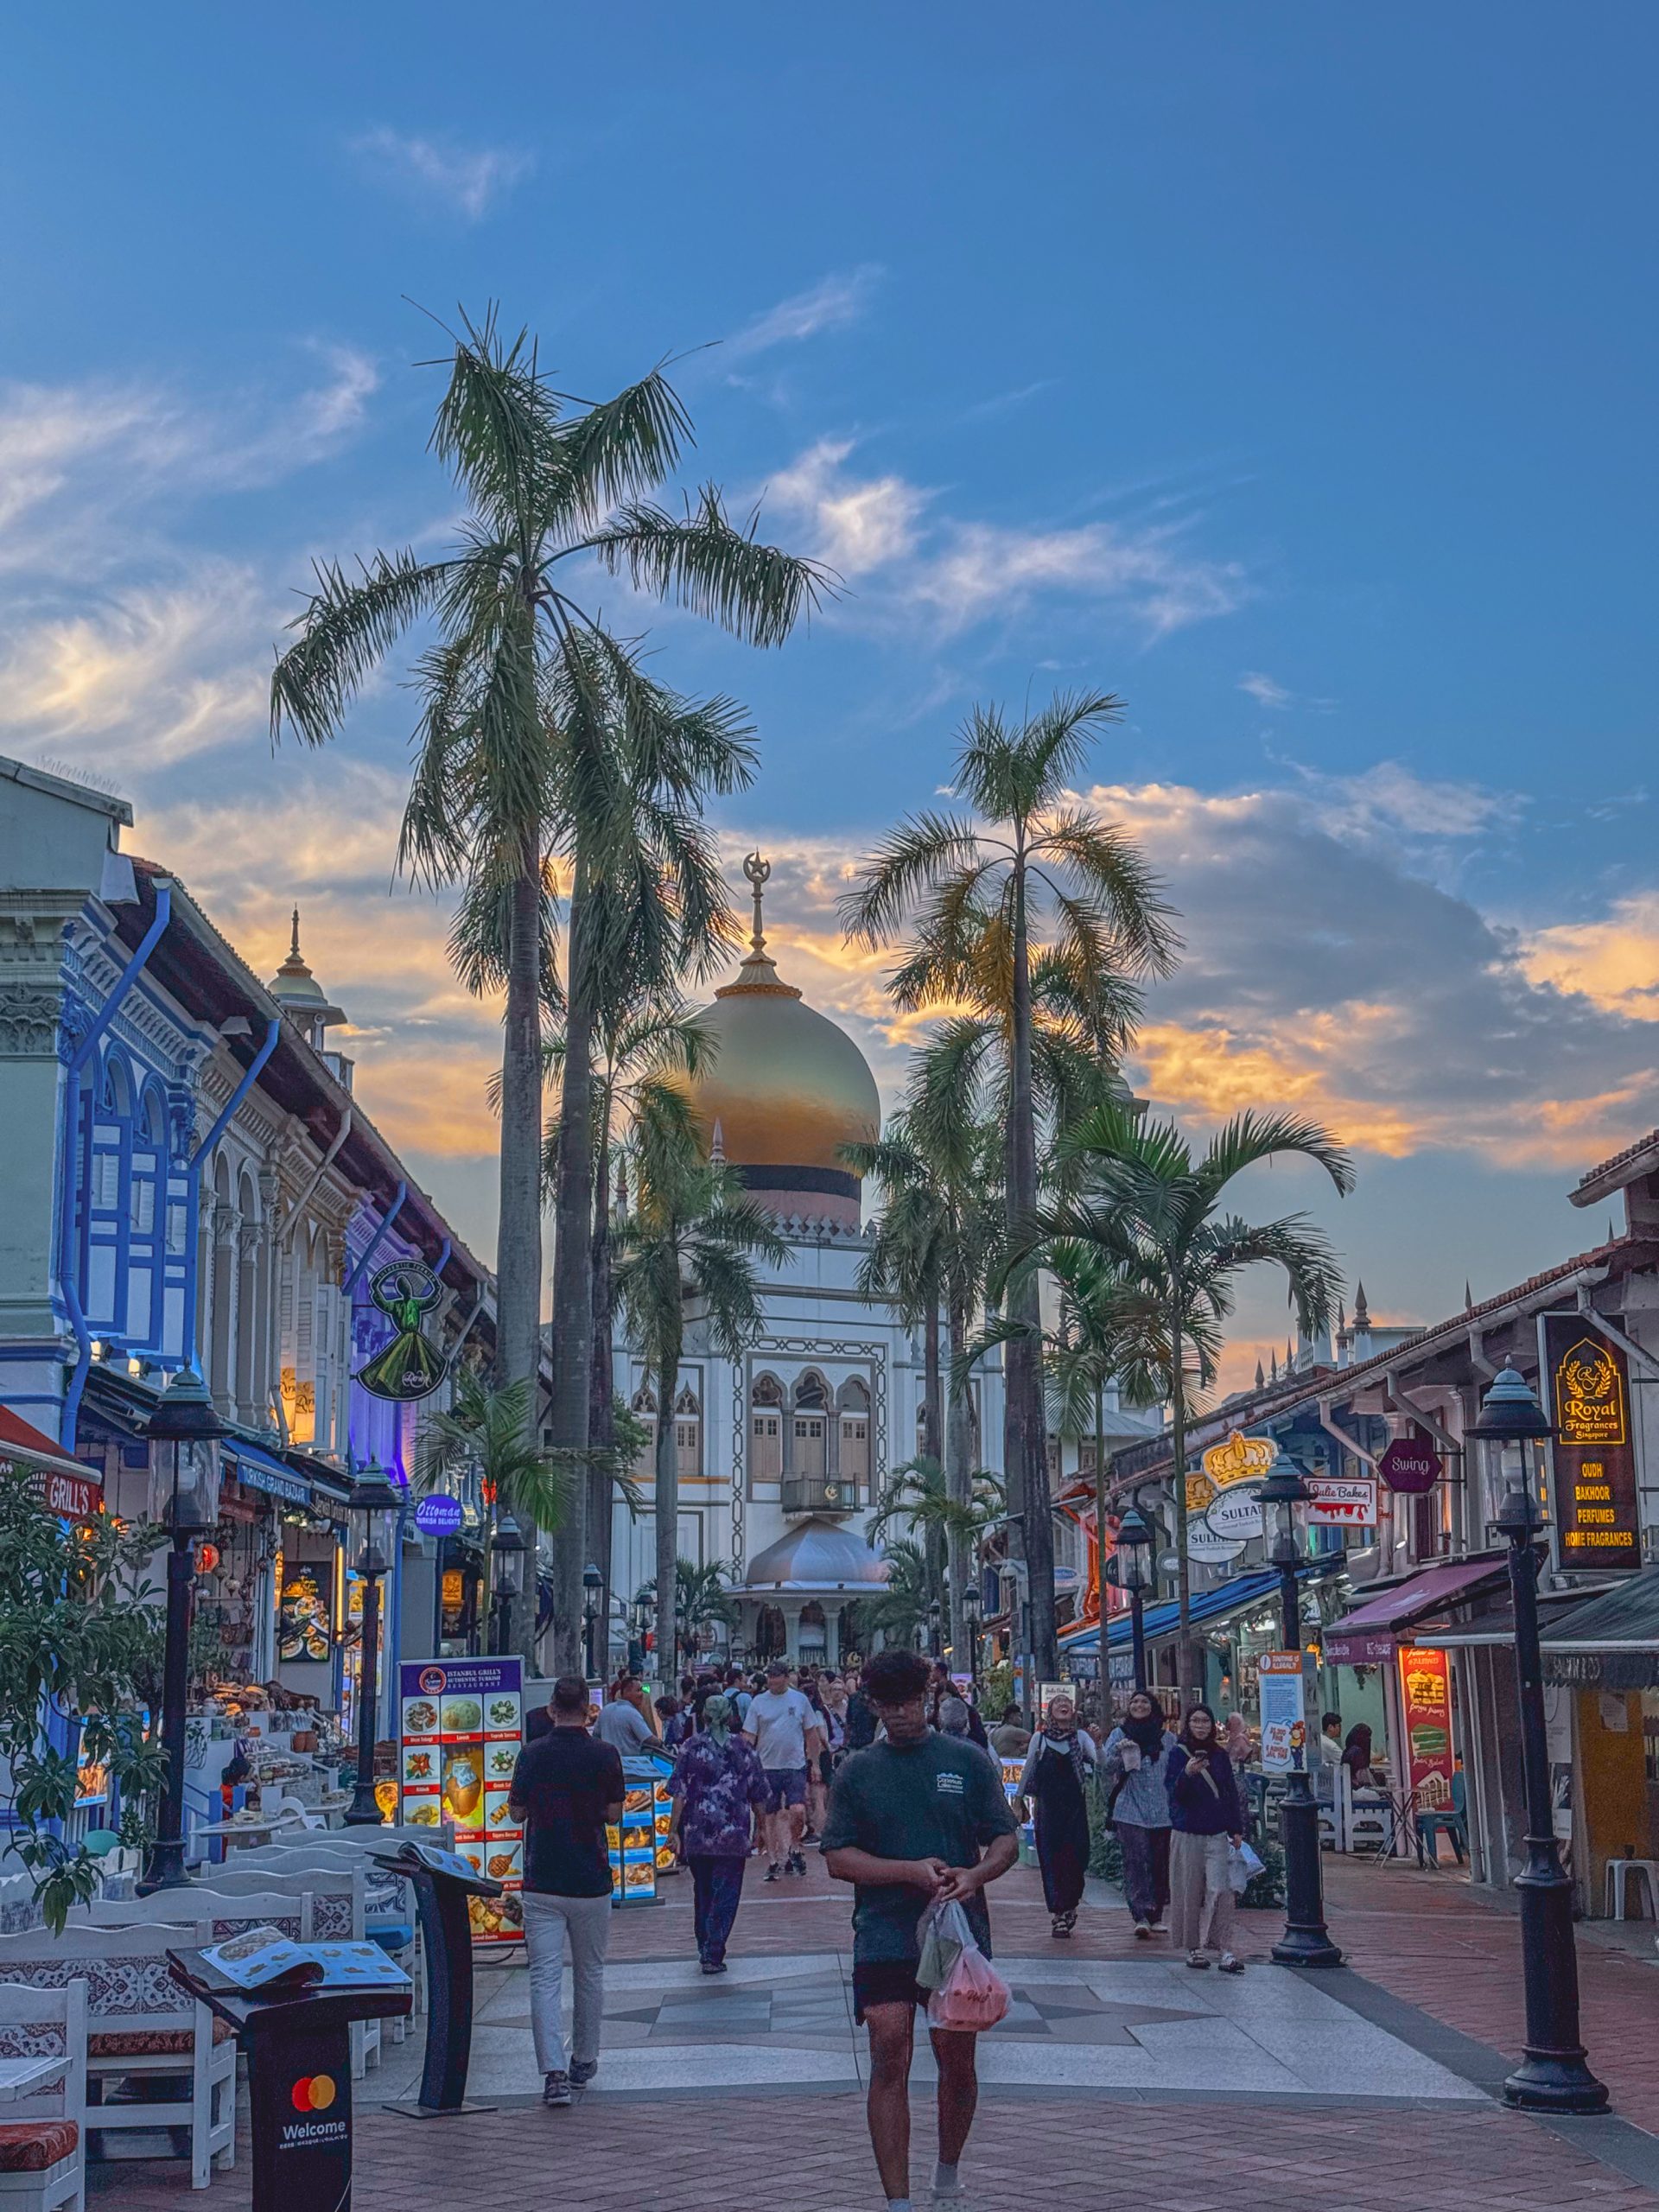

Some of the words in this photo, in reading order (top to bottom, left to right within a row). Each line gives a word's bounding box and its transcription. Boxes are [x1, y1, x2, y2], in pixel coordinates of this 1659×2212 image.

[377, 1262, 411, 1281] AUTHENTIC
[413, 1262, 436, 1283] TURKISH
[1564, 1401, 1617, 1421] Royal
[1565, 1420, 1618, 1432] Fragrances
[1575, 1431, 1609, 1440] Singapore
[1392, 1457, 1430, 1475] Swing
[1582, 1463, 1604, 1478] OUDH
[266, 1472, 285, 1495] GRAND
[1313, 1484, 1337, 1499] Julie
[1337, 1486, 1369, 1498] Bakes
[49, 1476, 89, 1516] GRILL'S
[1575, 1485, 1611, 1501] BAKHOOR
[416, 1500, 461, 1516] Ottoman
[1577, 1509, 1615, 1523] PERFUMES
[416, 1516, 437, 1525] TURKISH
[438, 1517, 461, 1526] DELIGHTS
[1564, 1532, 1586, 1547] HOME
[1586, 1532, 1632, 1547] FRAGRANCES
[283, 2121, 346, 2140] Welcome
